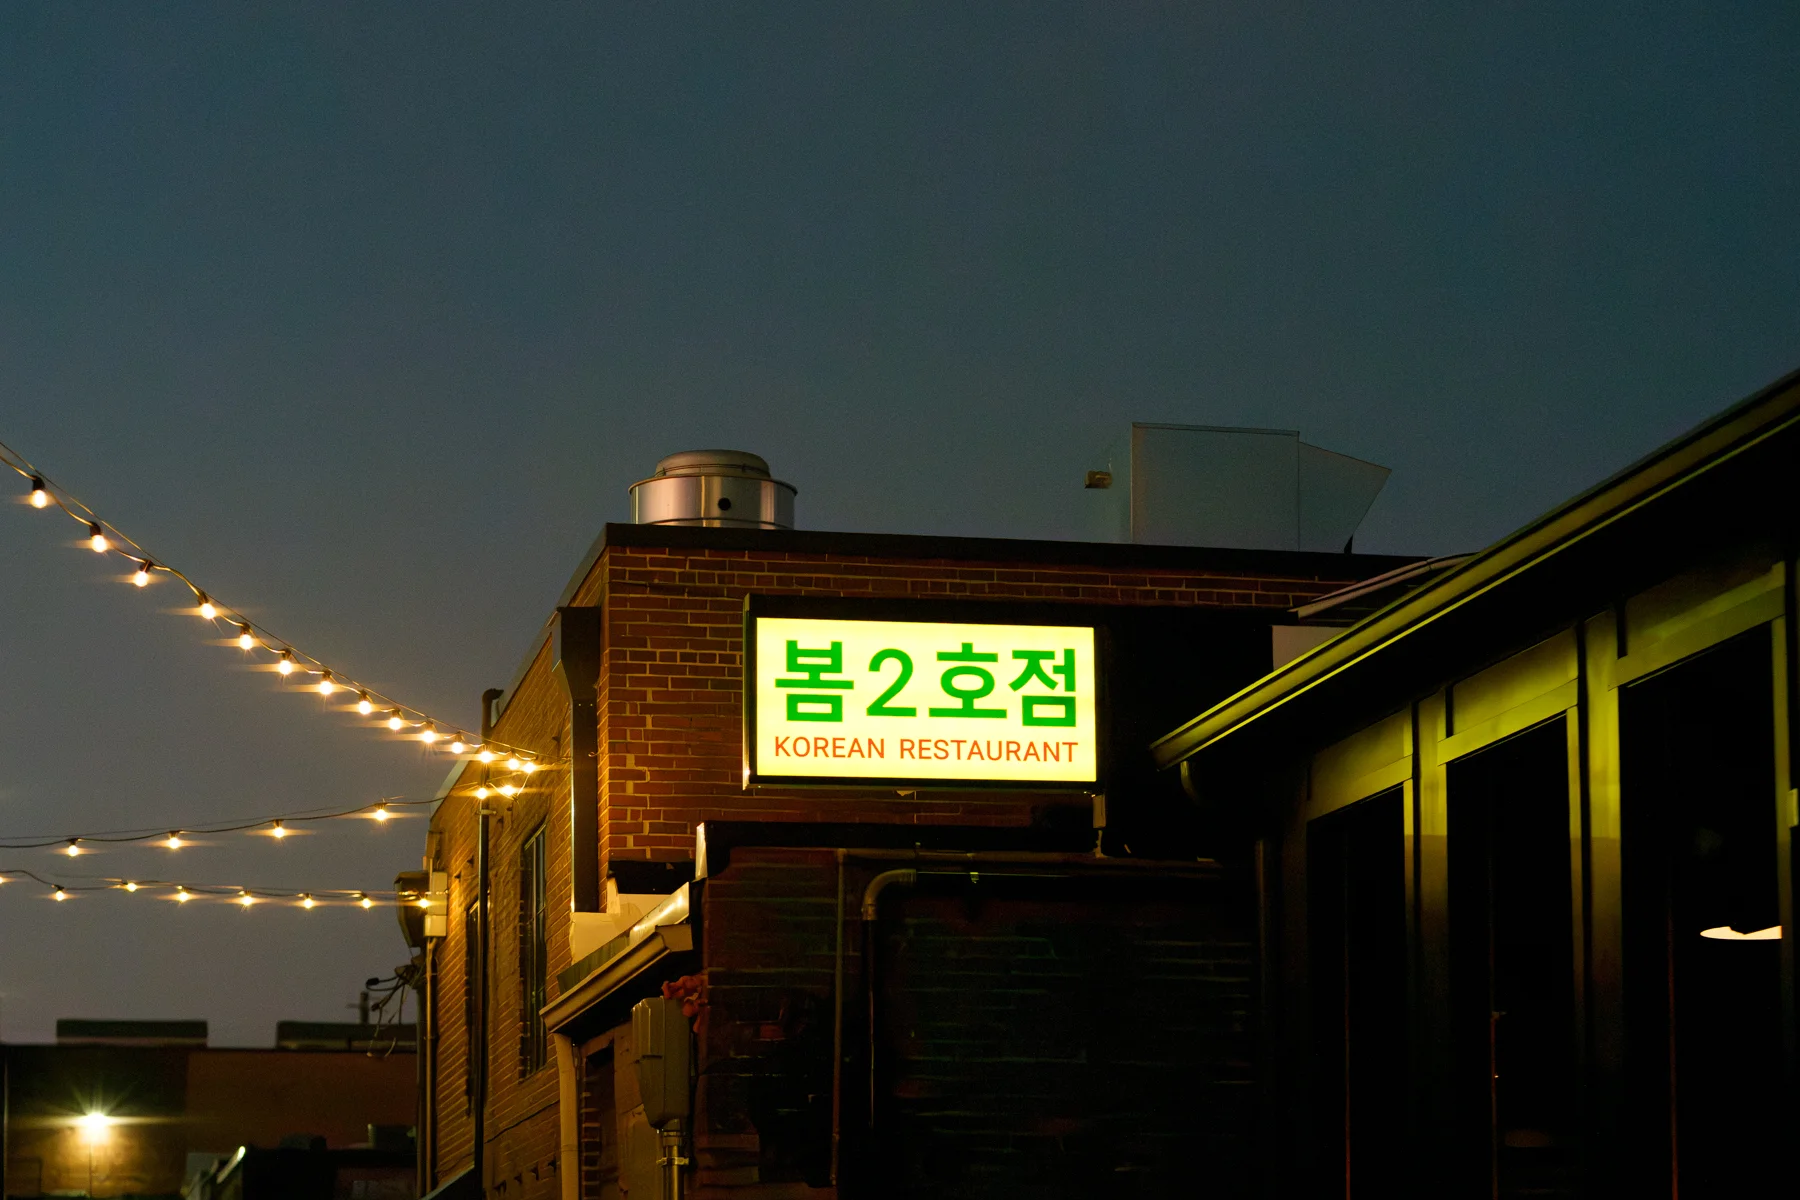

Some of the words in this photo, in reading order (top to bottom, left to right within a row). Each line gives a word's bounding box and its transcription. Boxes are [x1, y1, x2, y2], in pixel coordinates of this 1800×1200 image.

[774, 639, 1077, 728] 봄2호점
[775, 736, 885, 759] KOREAN
[900, 739, 1079, 763] RESTAURANT
